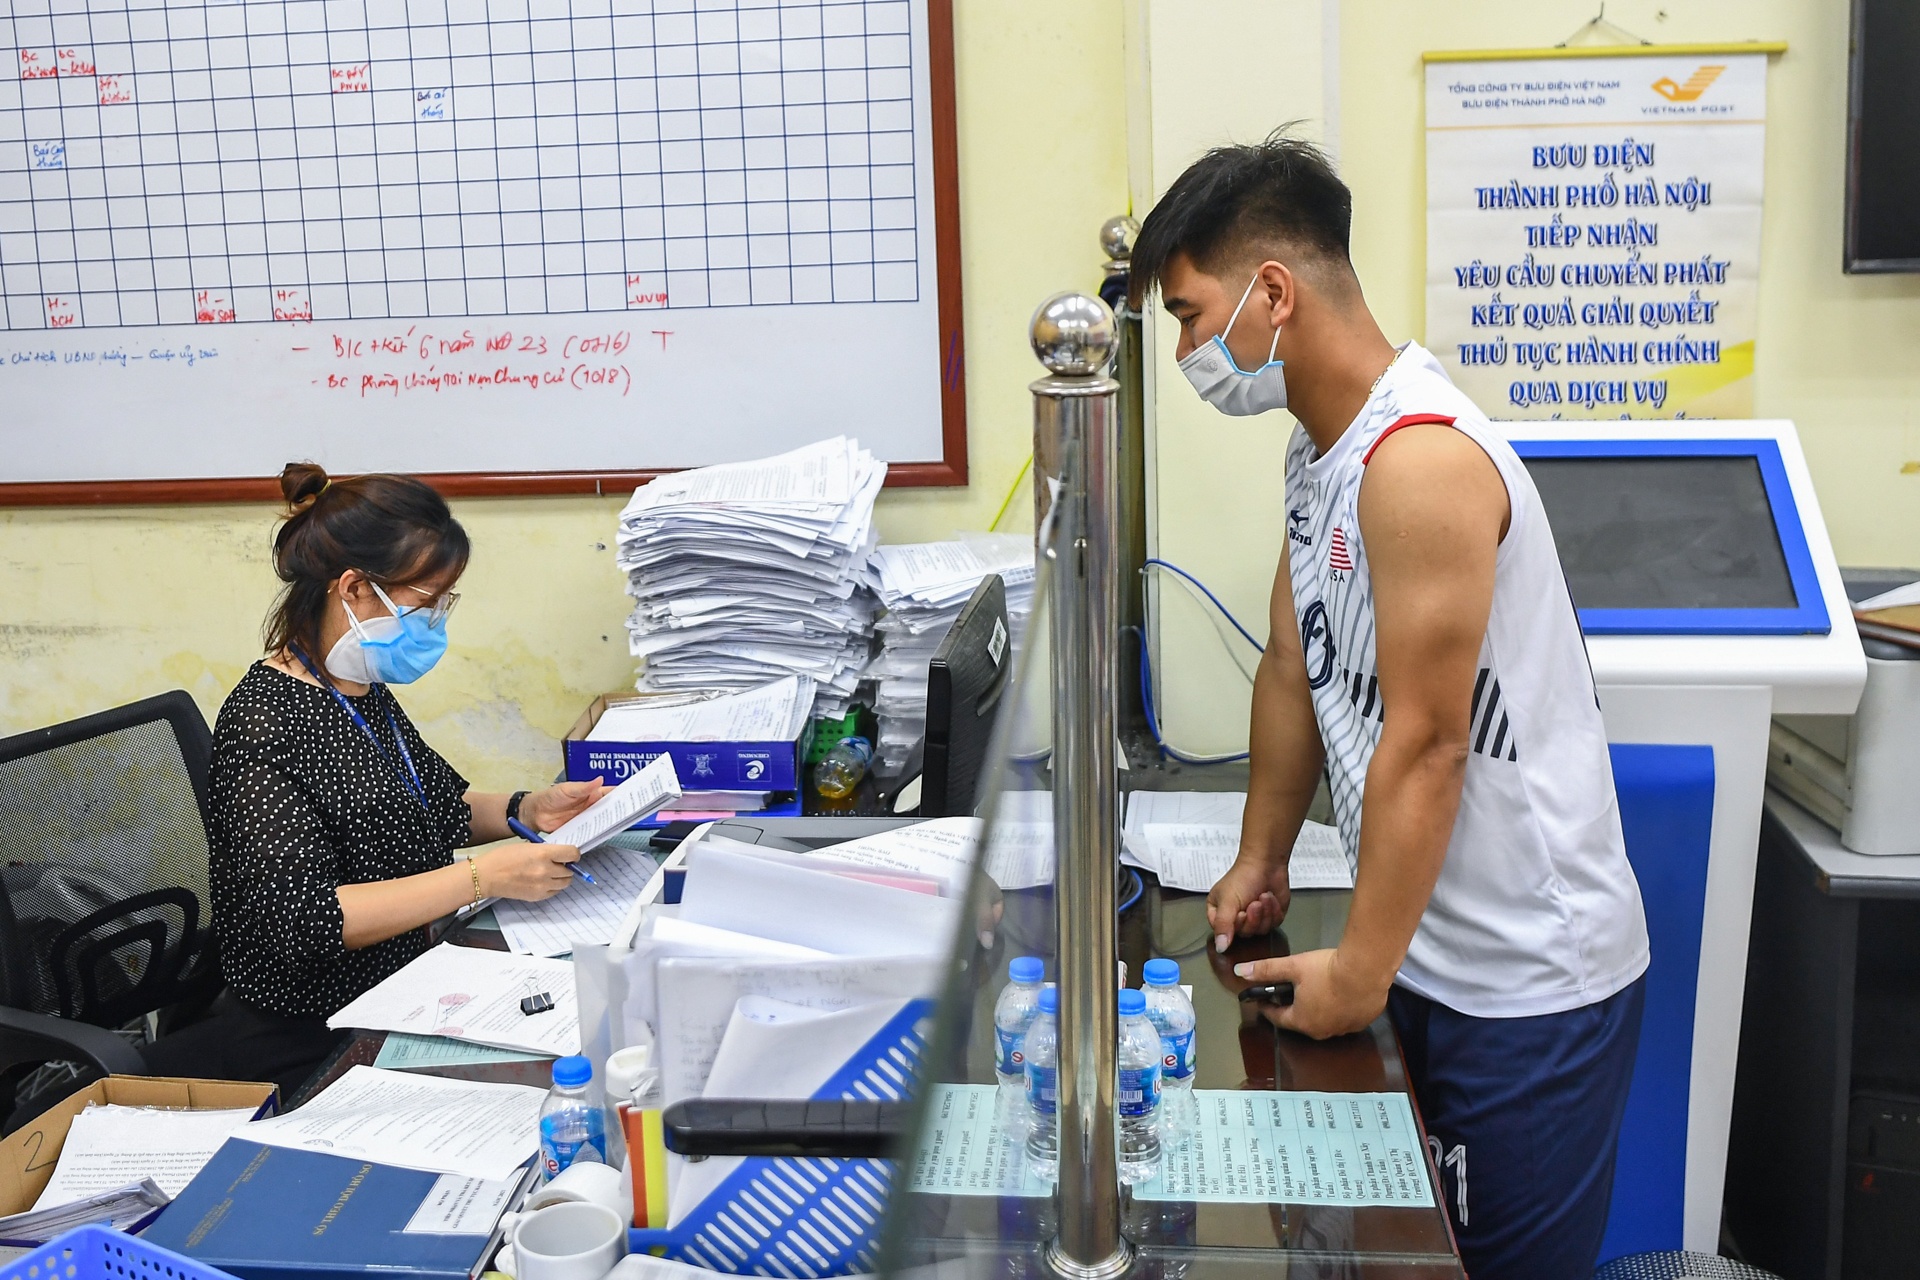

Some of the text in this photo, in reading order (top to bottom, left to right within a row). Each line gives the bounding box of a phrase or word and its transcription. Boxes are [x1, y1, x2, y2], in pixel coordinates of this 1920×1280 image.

[1448, 80, 1620, 93] TỔNG CÔNG TY BƯU ĐIỆN VIỆT NAM
[1462, 94, 1606, 109] BƯU ĐIỆN THÀNH PHỐ HÀ NỘI
[1641, 104, 1735, 114] VIETNAM POST
[1532, 138, 1655, 172] BƯU ĐIỆN
[1474, 173, 1711, 212] THÀNH PHỐ HÀ NỘI
[1524, 214, 1659, 254] TIẾP NHẬN
[1454, 249, 1731, 289] YÊU CẦU CHUYỂN PHÁT
[1470, 290, 1718, 328] KẾT QUẢ GIẢI QUYẾT
[419, 334, 433, 359] 6
[518, 336, 548, 354] 23
[1457, 335, 1720, 371] THỦ TỤC HÀNH CHÍNH
[328, 374, 348, 388] BC
[1508, 380, 1668, 409] QUA DỊCH VỤ
[23, 1131, 57, 1172] 2
[321, 1202, 344, 1223] THEO
